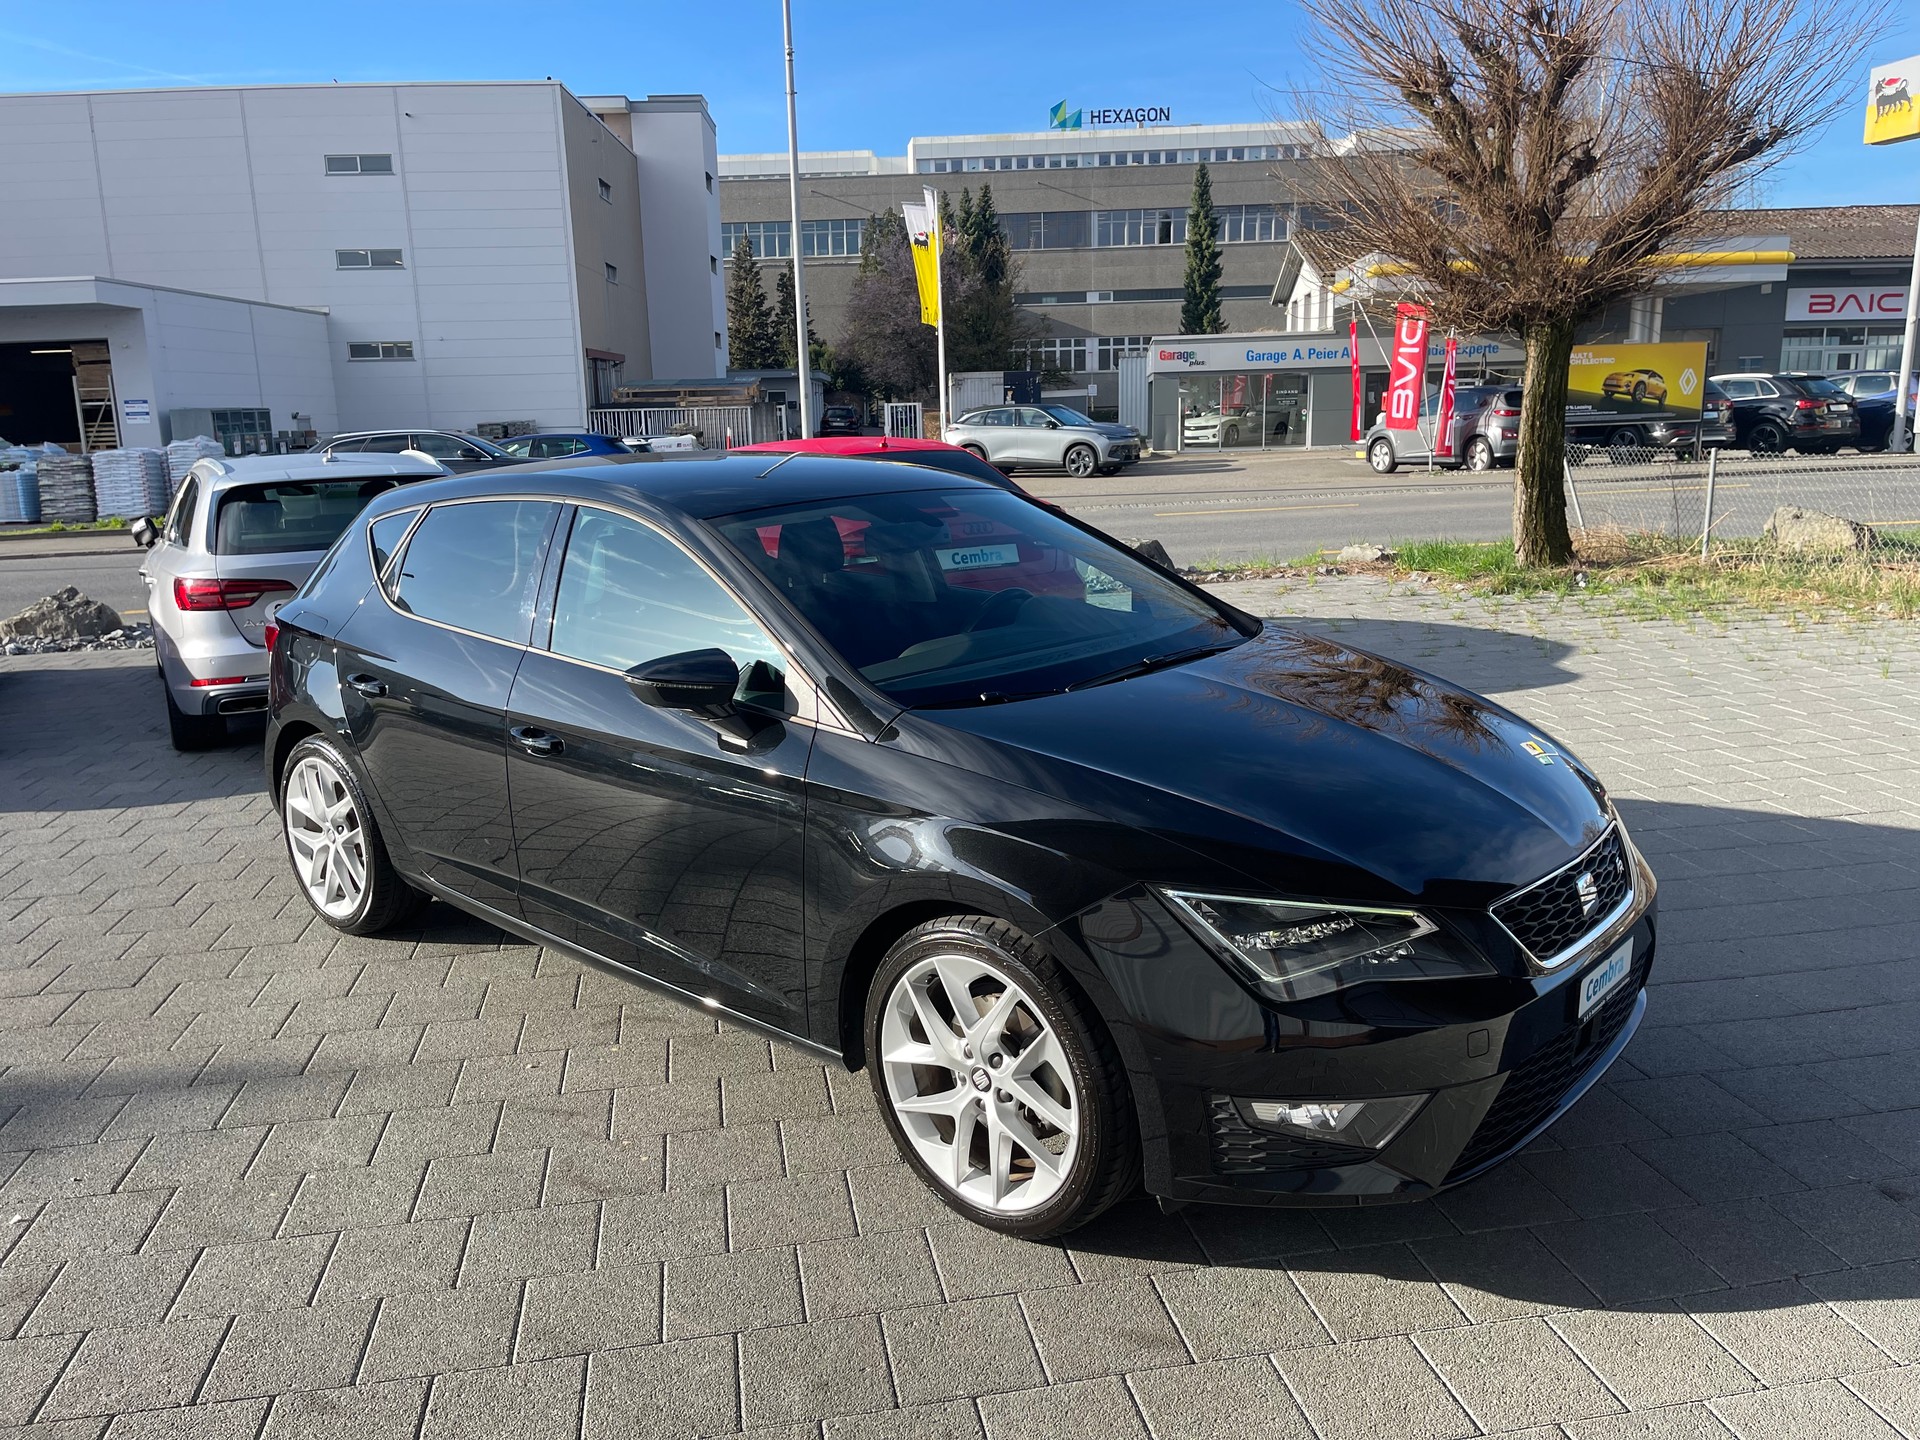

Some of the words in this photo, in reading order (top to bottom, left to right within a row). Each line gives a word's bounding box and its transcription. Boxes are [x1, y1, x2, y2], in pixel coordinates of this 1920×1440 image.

[1090, 106, 1170, 125] HEXAGON
[1808, 293, 1905, 314] BAIC
[1159, 350, 1195, 362] Garage
[1246, 349, 1287, 363] Garage
[1293, 348, 1305, 360] A.
[1308, 347, 1339, 360] Peier
[1341, 346, 1352, 359] A
[951, 548, 1003, 565] Cembra
[243, 619, 266, 628] A4
[1585, 956, 1624, 1002] Cembra
